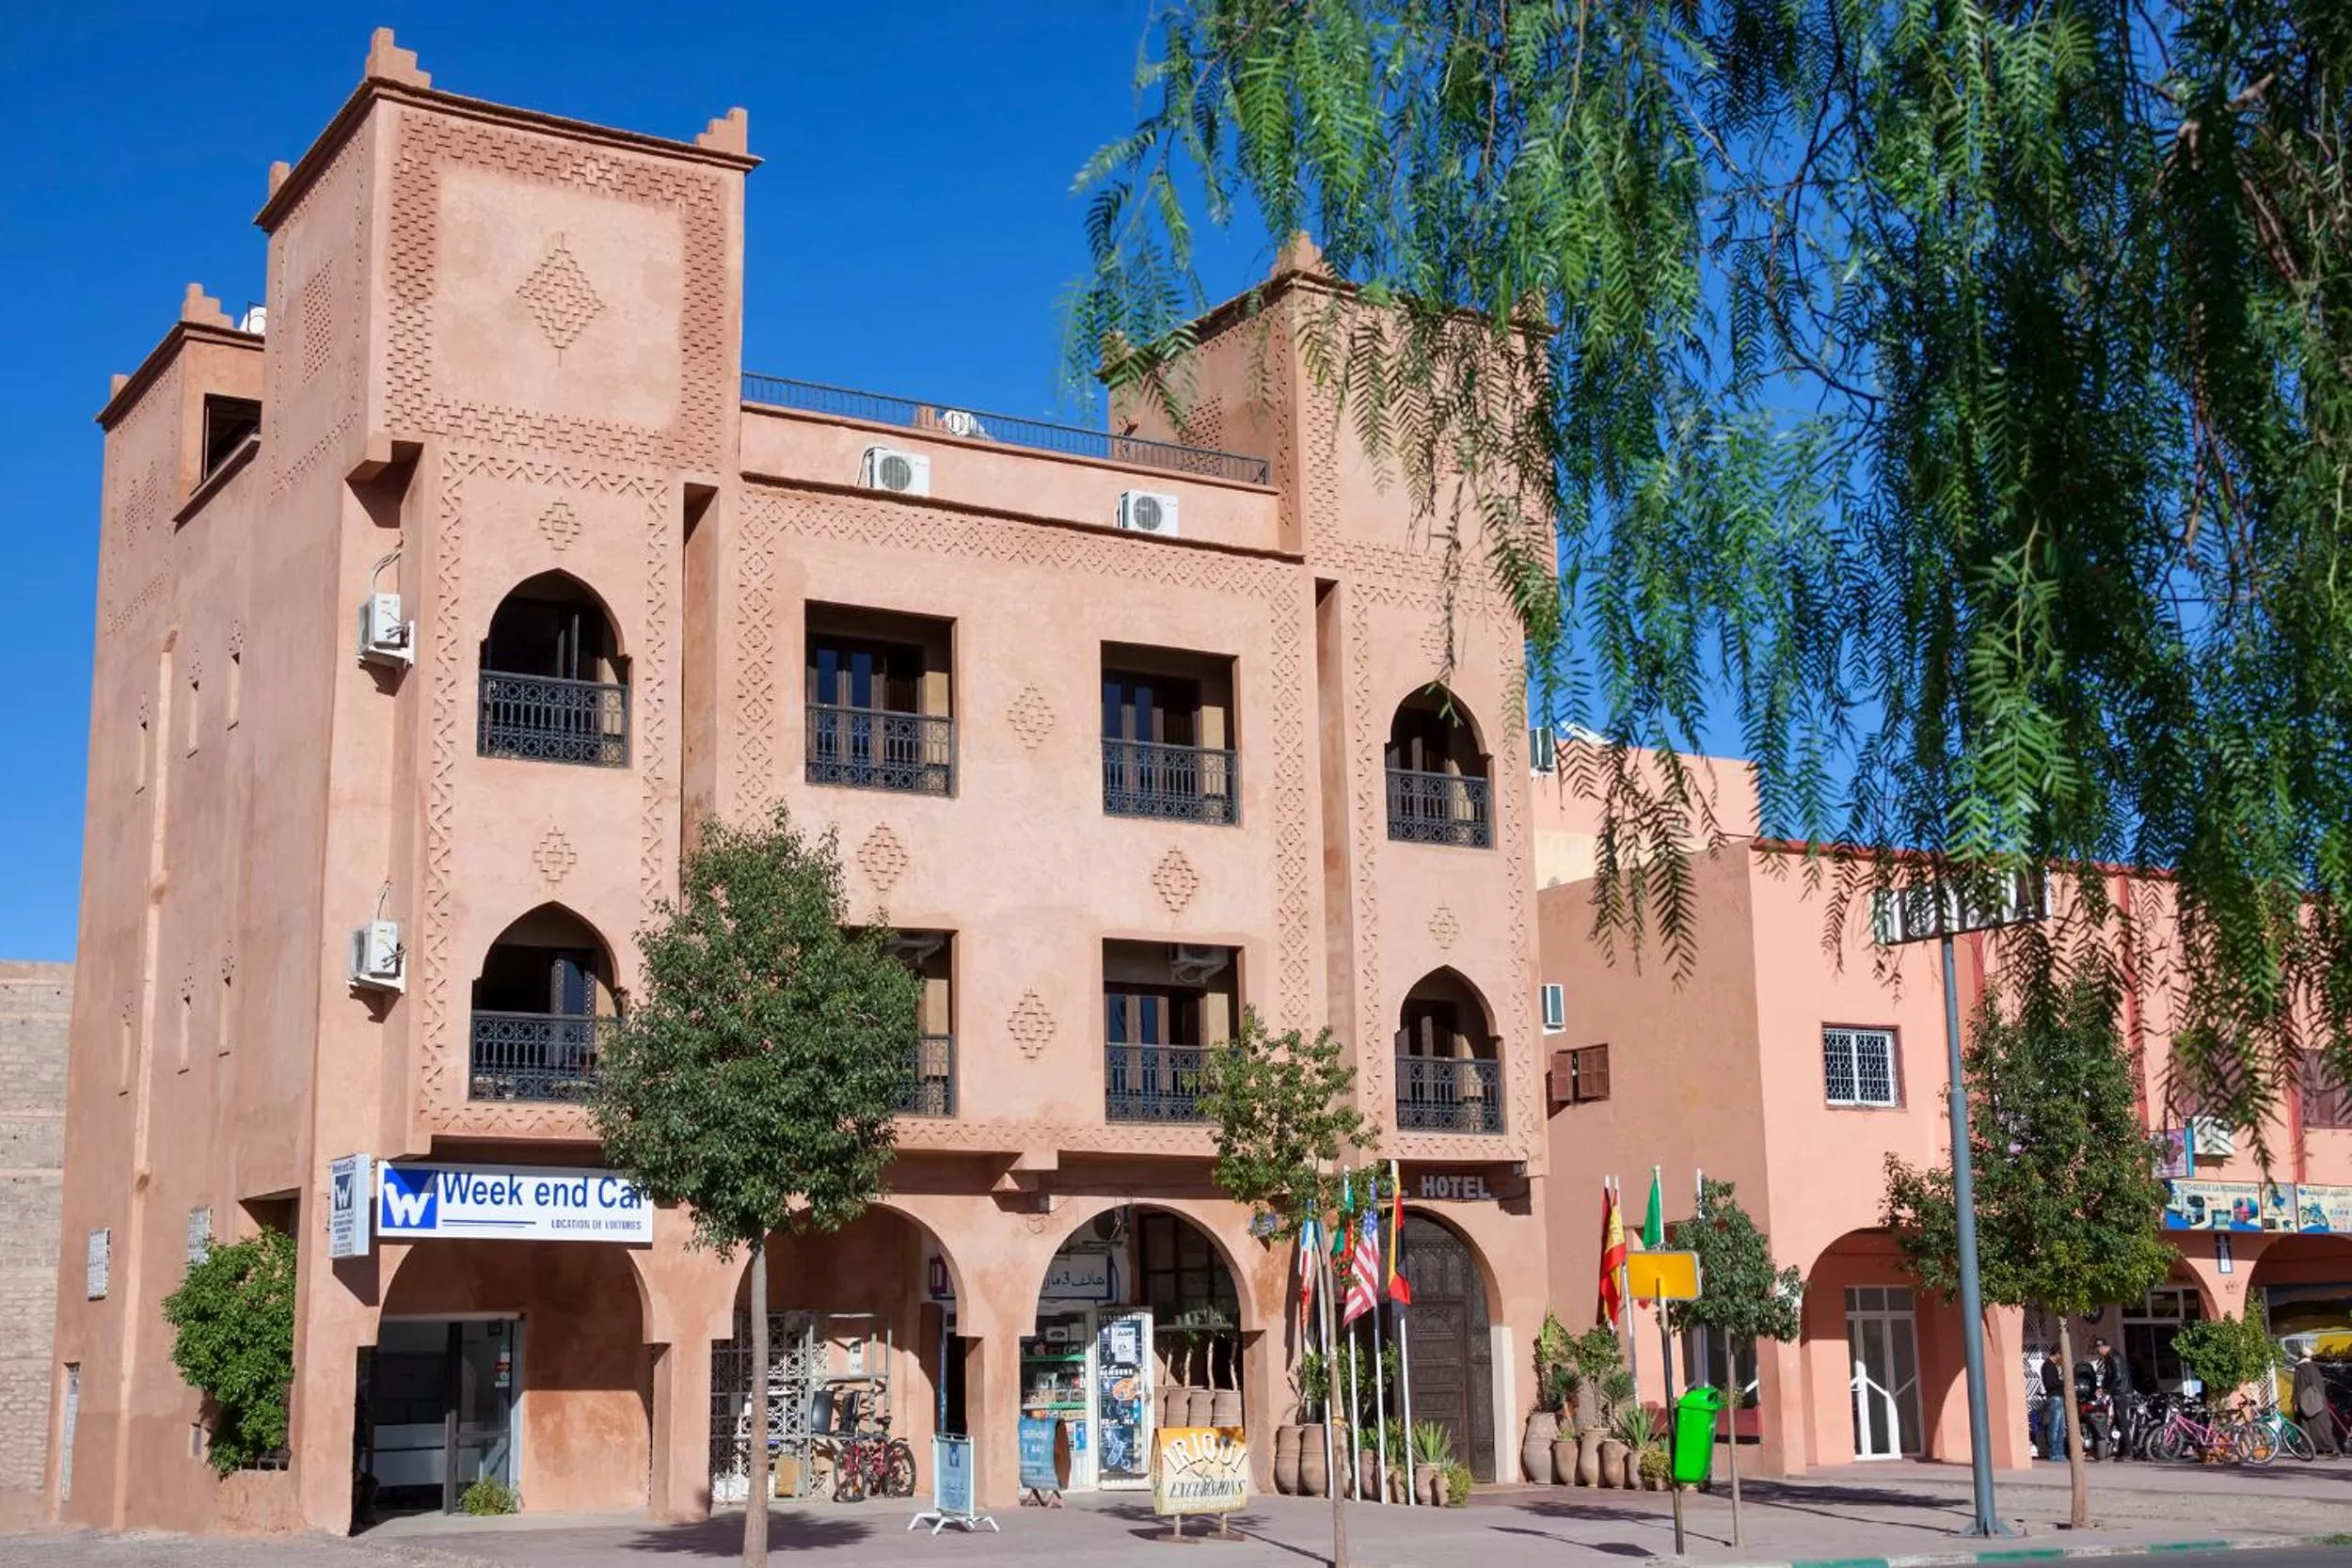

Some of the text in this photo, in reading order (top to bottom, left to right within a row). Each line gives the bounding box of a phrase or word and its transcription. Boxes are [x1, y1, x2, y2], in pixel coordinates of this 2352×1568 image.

[442, 1172, 523, 1206] Week
[534, 1177, 588, 1208] end
[1422, 1176, 1491, 1198] HOTEL
[551, 1219, 642, 1230] LOCATION DE VOITURES
[1169, 1478, 1247, 1498] EXCURSIONS
